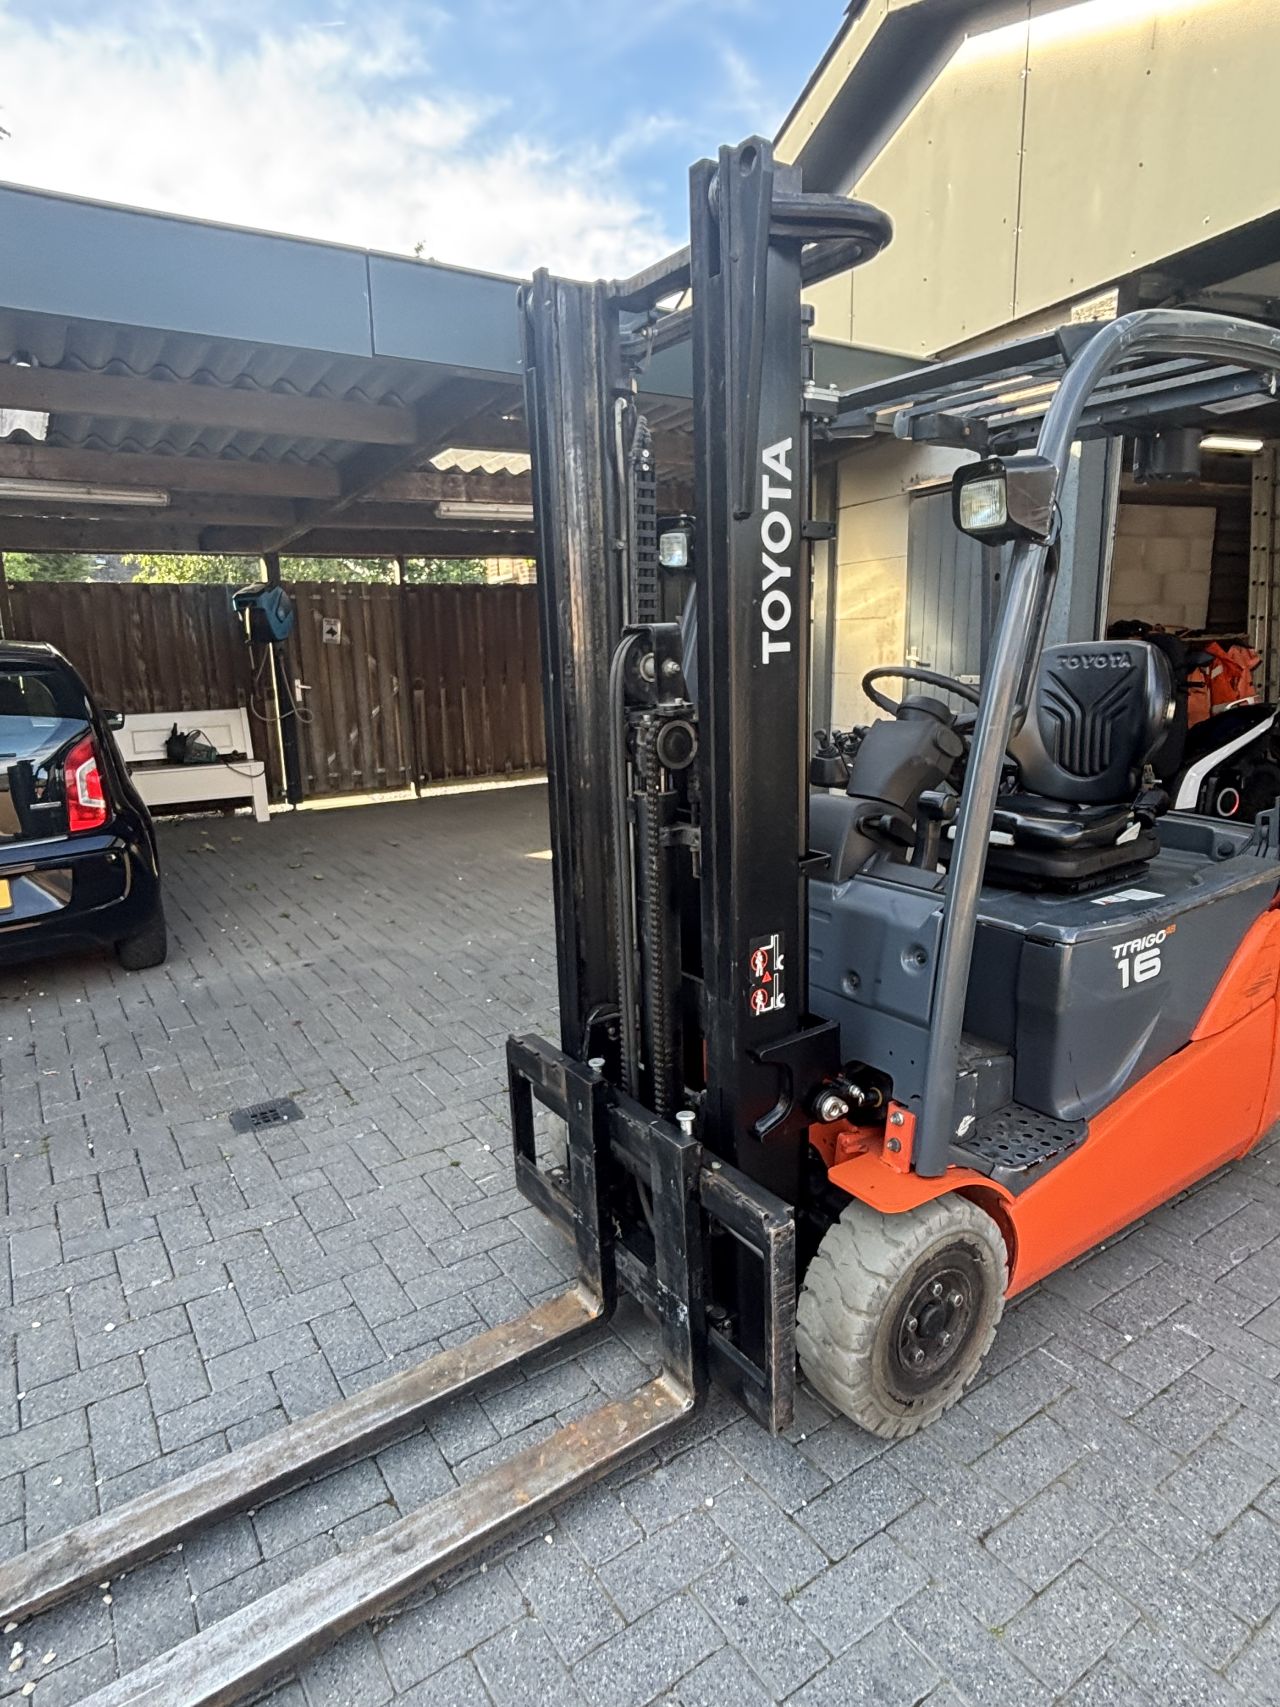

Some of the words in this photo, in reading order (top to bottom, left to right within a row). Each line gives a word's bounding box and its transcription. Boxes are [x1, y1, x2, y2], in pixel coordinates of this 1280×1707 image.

[761, 437, 793, 664] TOYOTA
[1057, 651, 1132, 669] TOYOTA
[1117, 947, 1162, 989] 16
